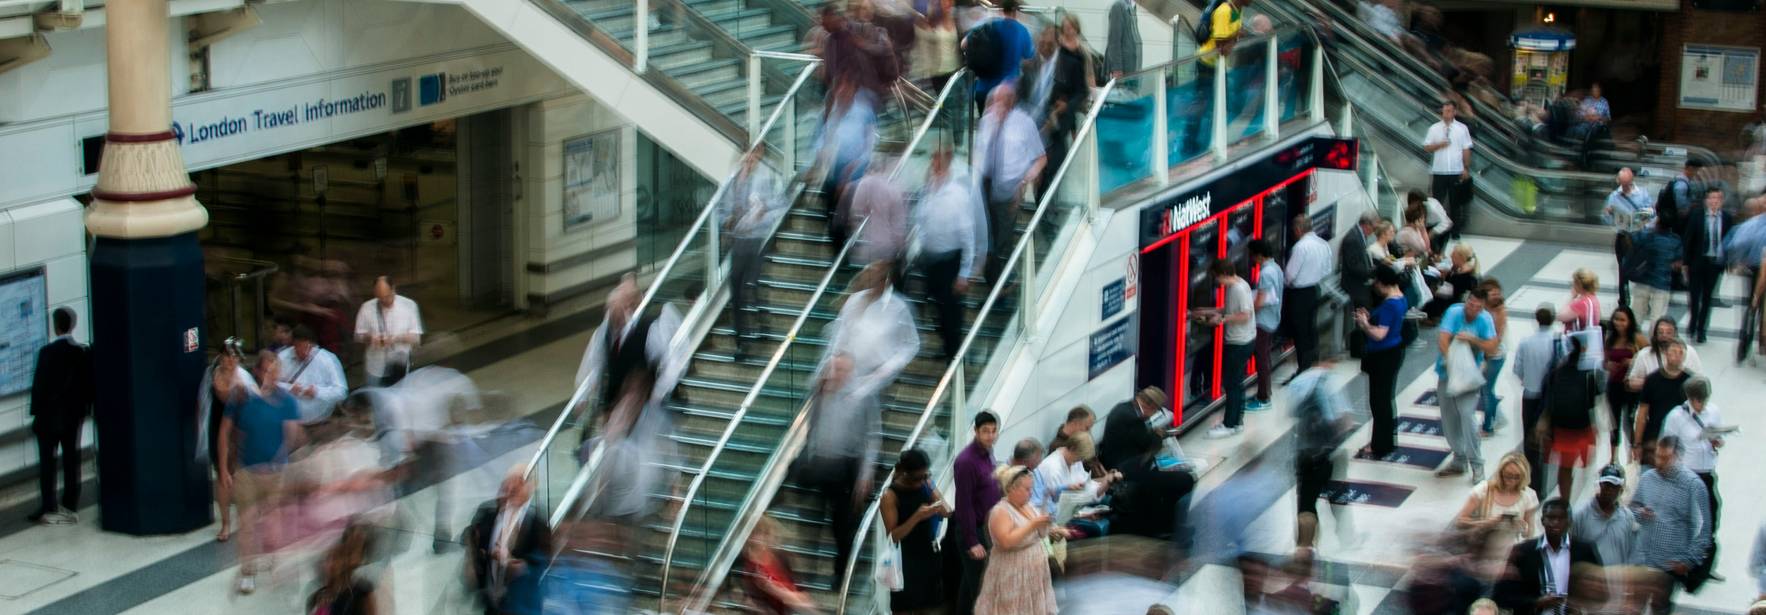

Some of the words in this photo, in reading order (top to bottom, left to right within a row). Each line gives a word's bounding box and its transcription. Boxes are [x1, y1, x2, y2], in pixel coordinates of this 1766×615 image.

[189, 116, 248, 144] London
[253, 104, 299, 130] Travel
[305, 91, 386, 122] Information
[1173, 190, 1212, 233] NatWest
